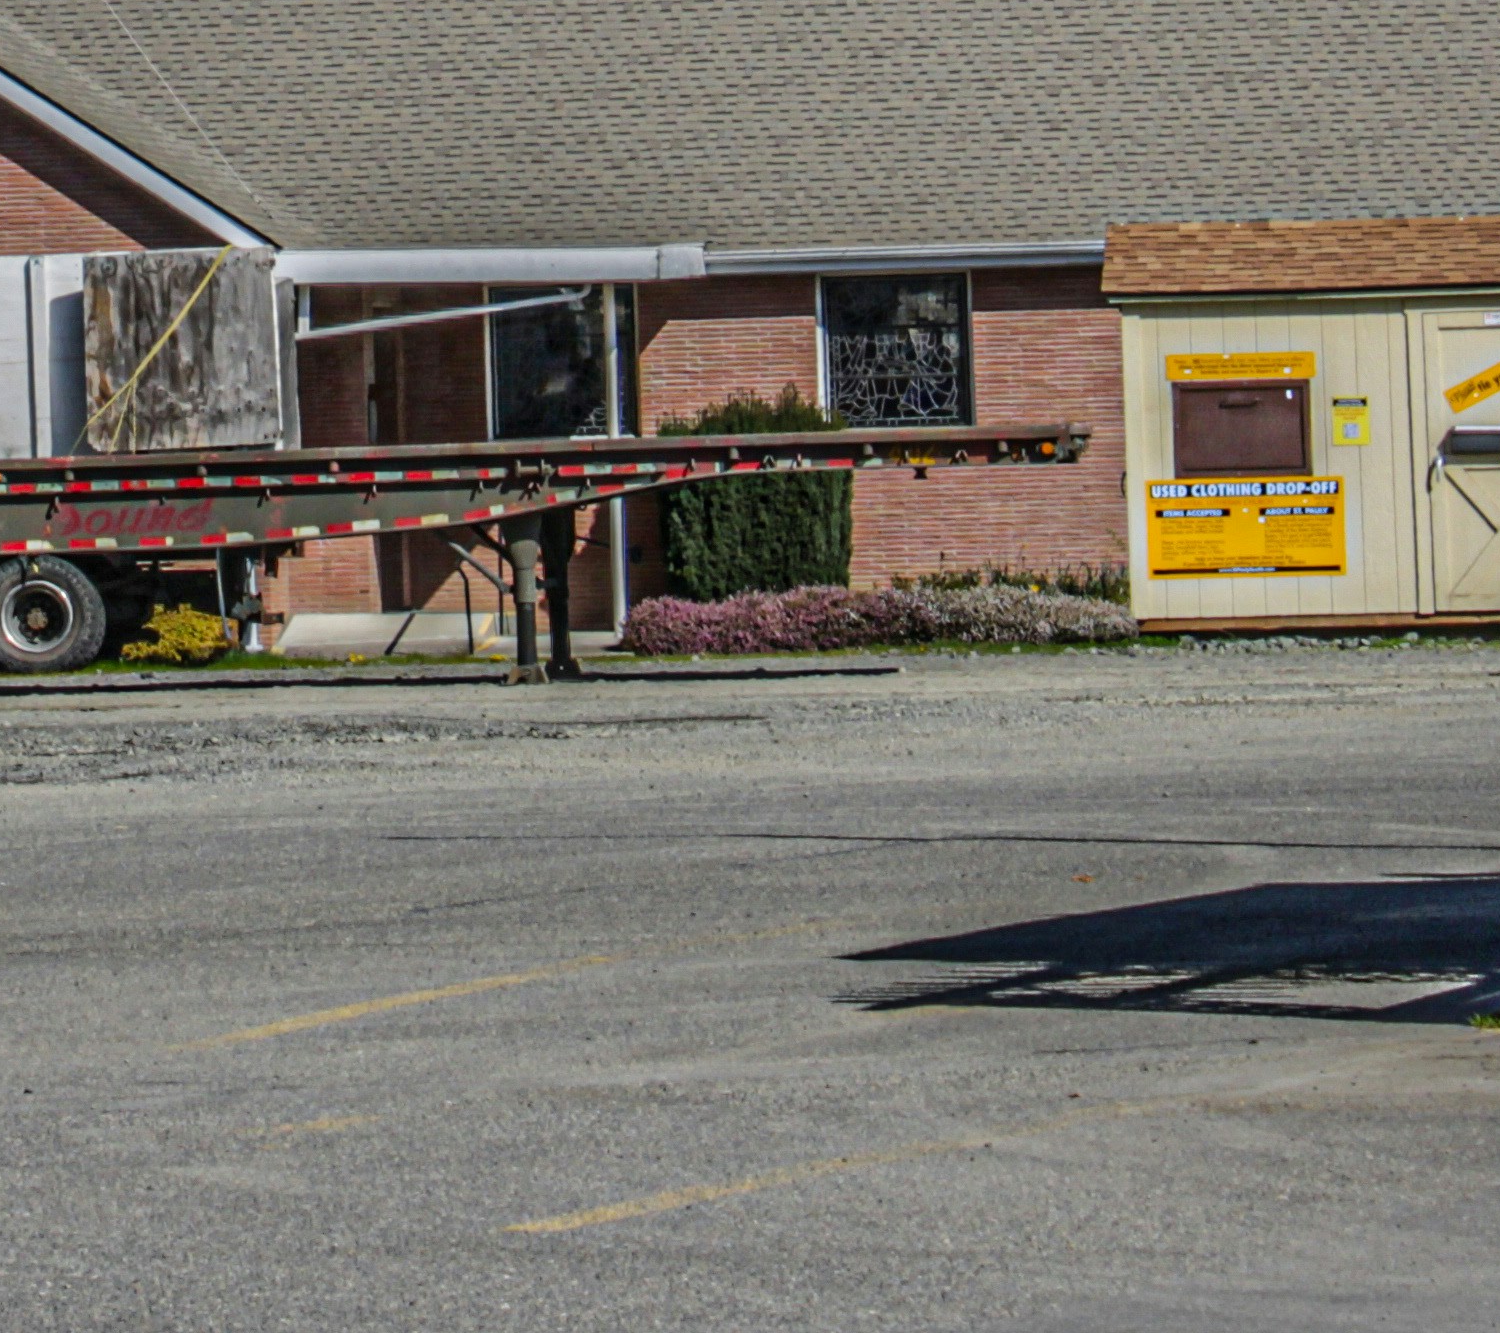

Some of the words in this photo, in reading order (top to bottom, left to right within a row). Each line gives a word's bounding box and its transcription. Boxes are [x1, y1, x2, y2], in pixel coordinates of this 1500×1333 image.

[1151, 484, 1188, 498] USED
[1191, 483, 1263, 497] CLOTHING
[1265, 481, 1338, 495] DROP-OFF
